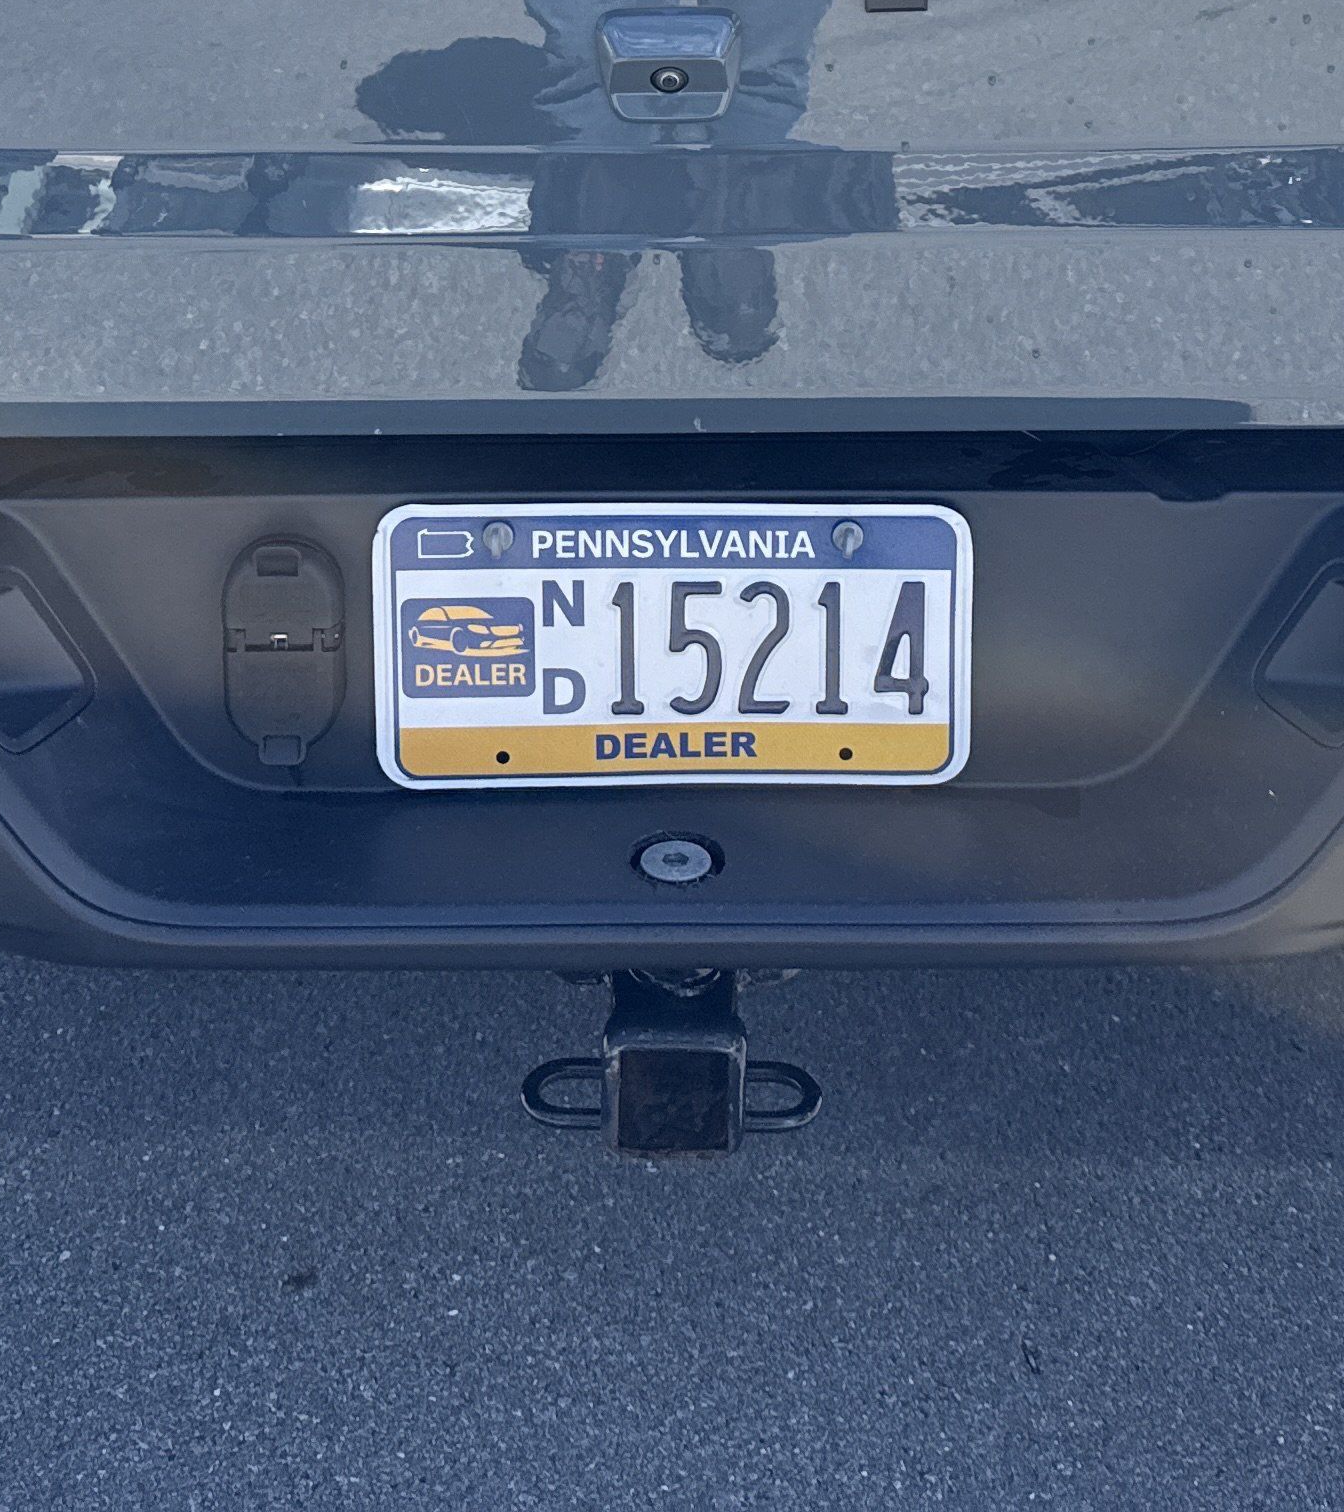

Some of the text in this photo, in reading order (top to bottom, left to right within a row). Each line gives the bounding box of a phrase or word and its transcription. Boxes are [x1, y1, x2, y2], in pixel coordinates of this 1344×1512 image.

[531, 529, 816, 560] PENNSYLVANIA
[542, 580, 585, 627] N
[608, 580, 931, 716] 15214
[414, 663, 527, 687] DEALER
[543, 669, 587, 715] D
[596, 731, 757, 760] DEALER
